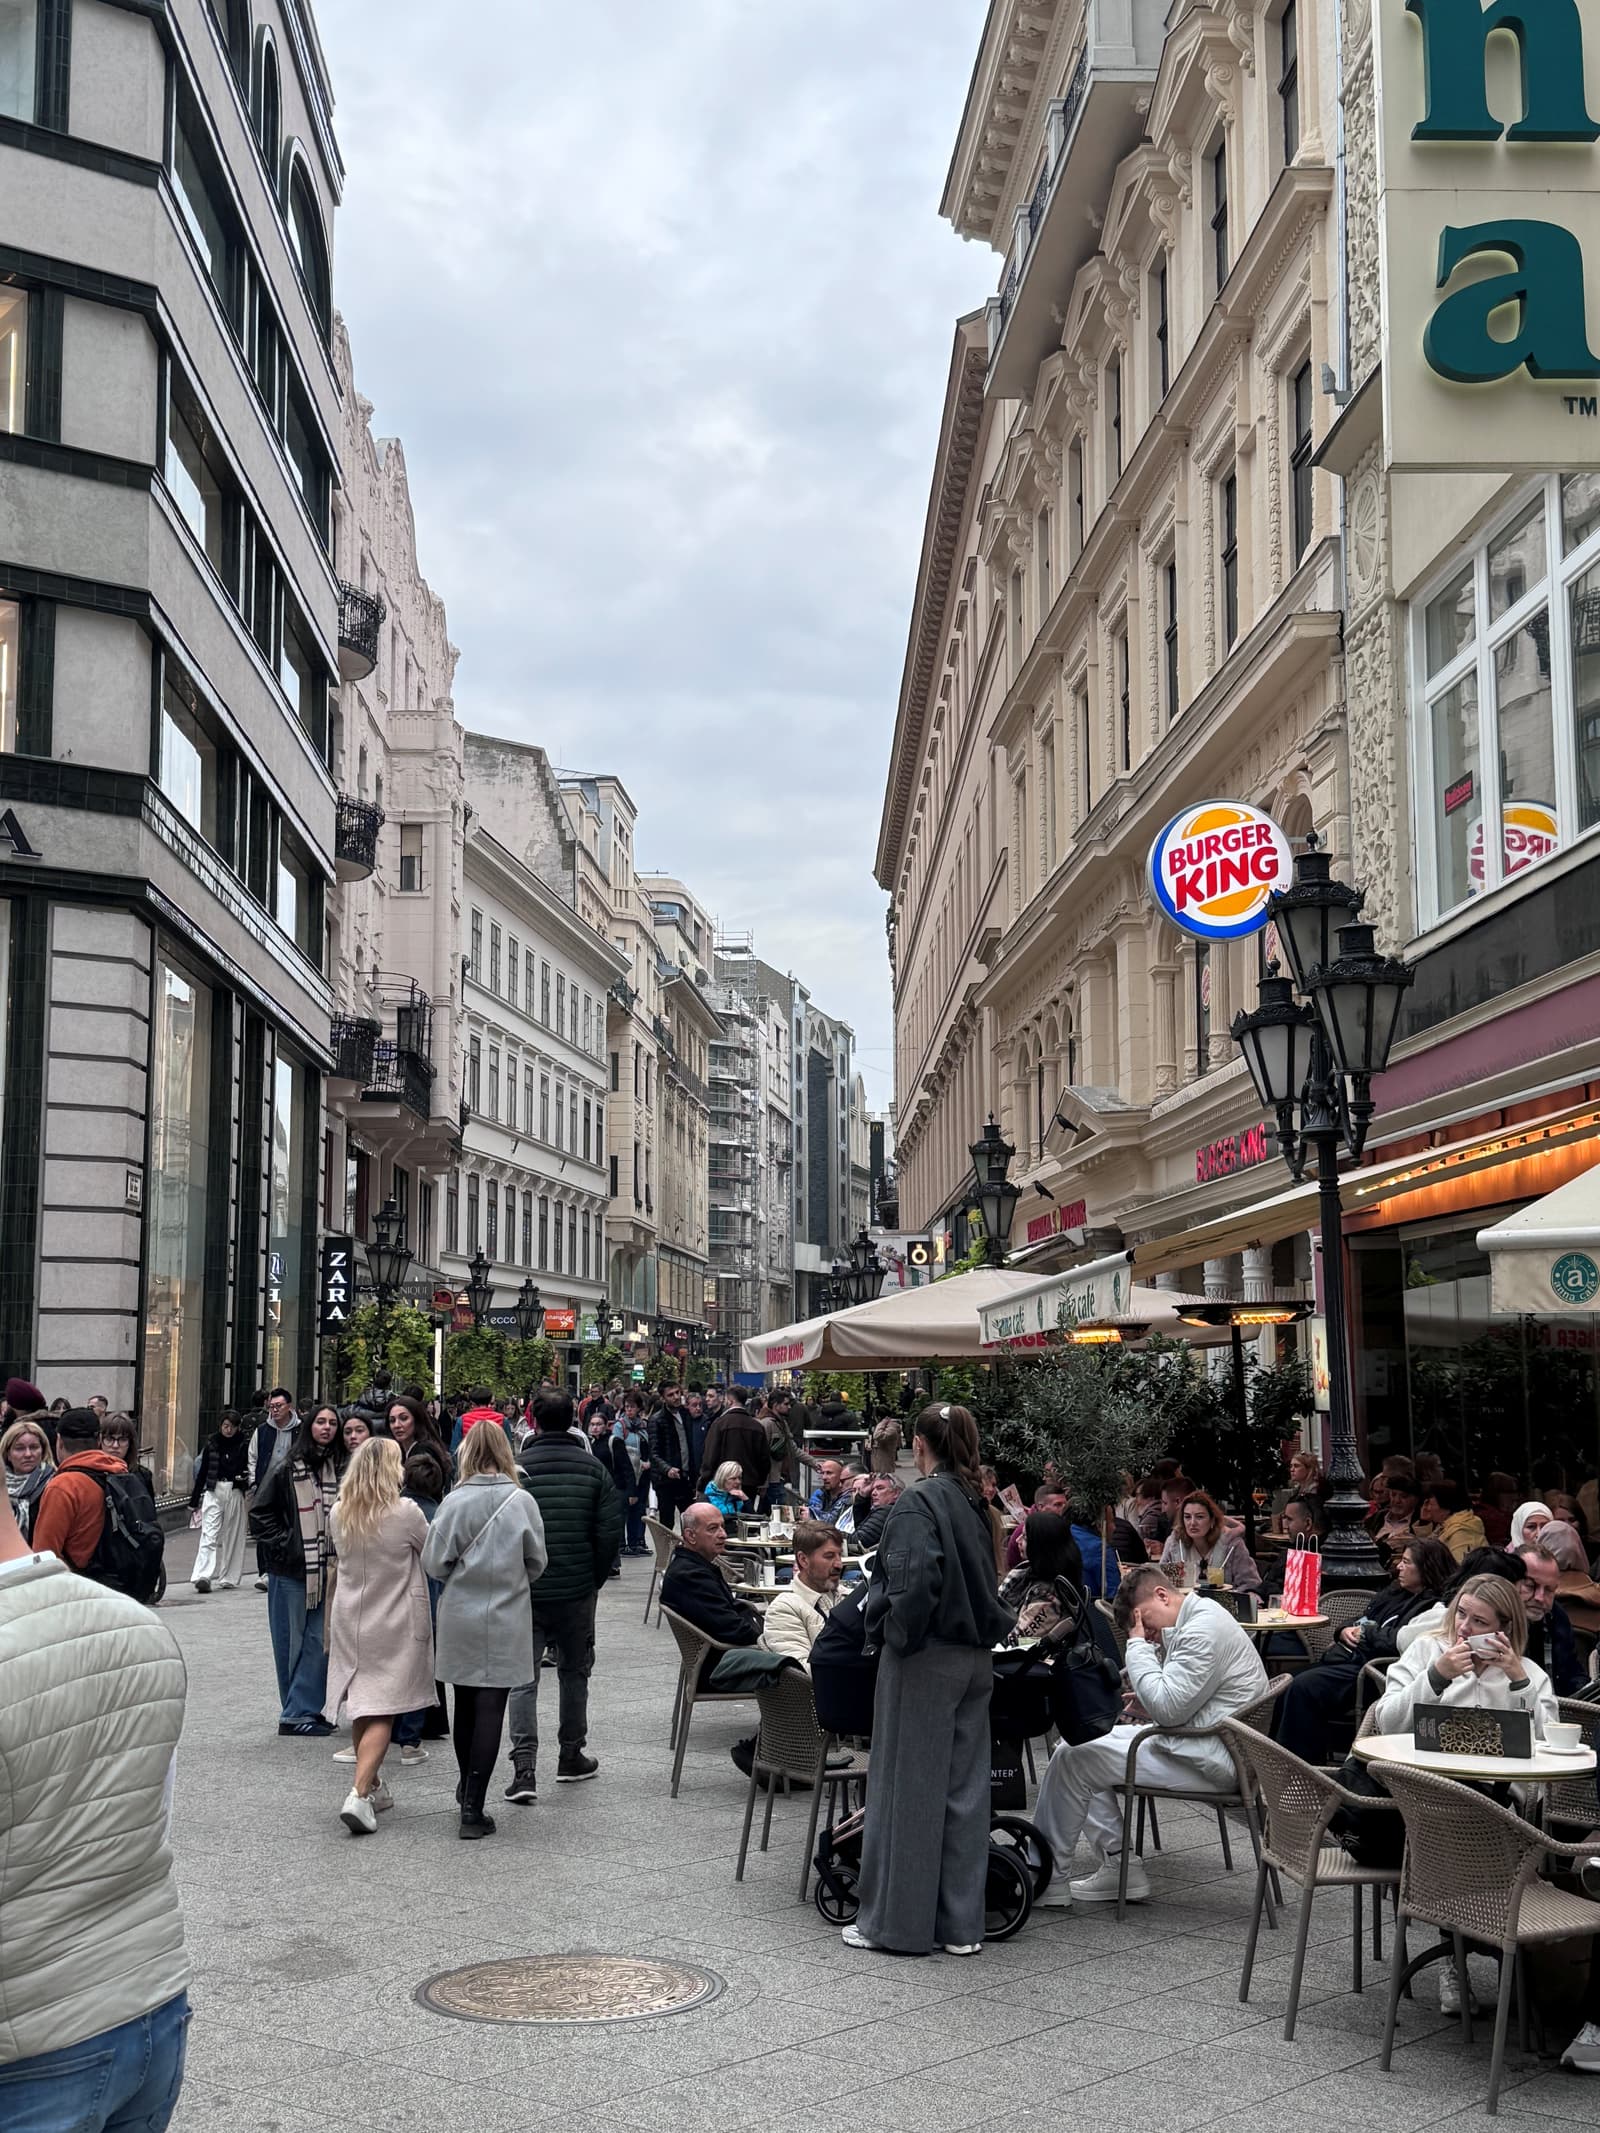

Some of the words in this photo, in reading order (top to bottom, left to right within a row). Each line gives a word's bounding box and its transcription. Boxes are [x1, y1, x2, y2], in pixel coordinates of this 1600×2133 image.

[1169, 823, 1273, 877] BURGER
[1175, 846, 1279, 912] KING
[1195, 1135, 1236, 1183] BURGER
[1240, 1121, 1267, 1169] KING
[327, 1251, 348, 1320] ZARA
[1077, 1280, 1096, 1320] café
[490, 1316, 517, 1325] ecco
[766, 1345, 787, 1365] BURGER
[788, 1342, 804, 1361] KING
